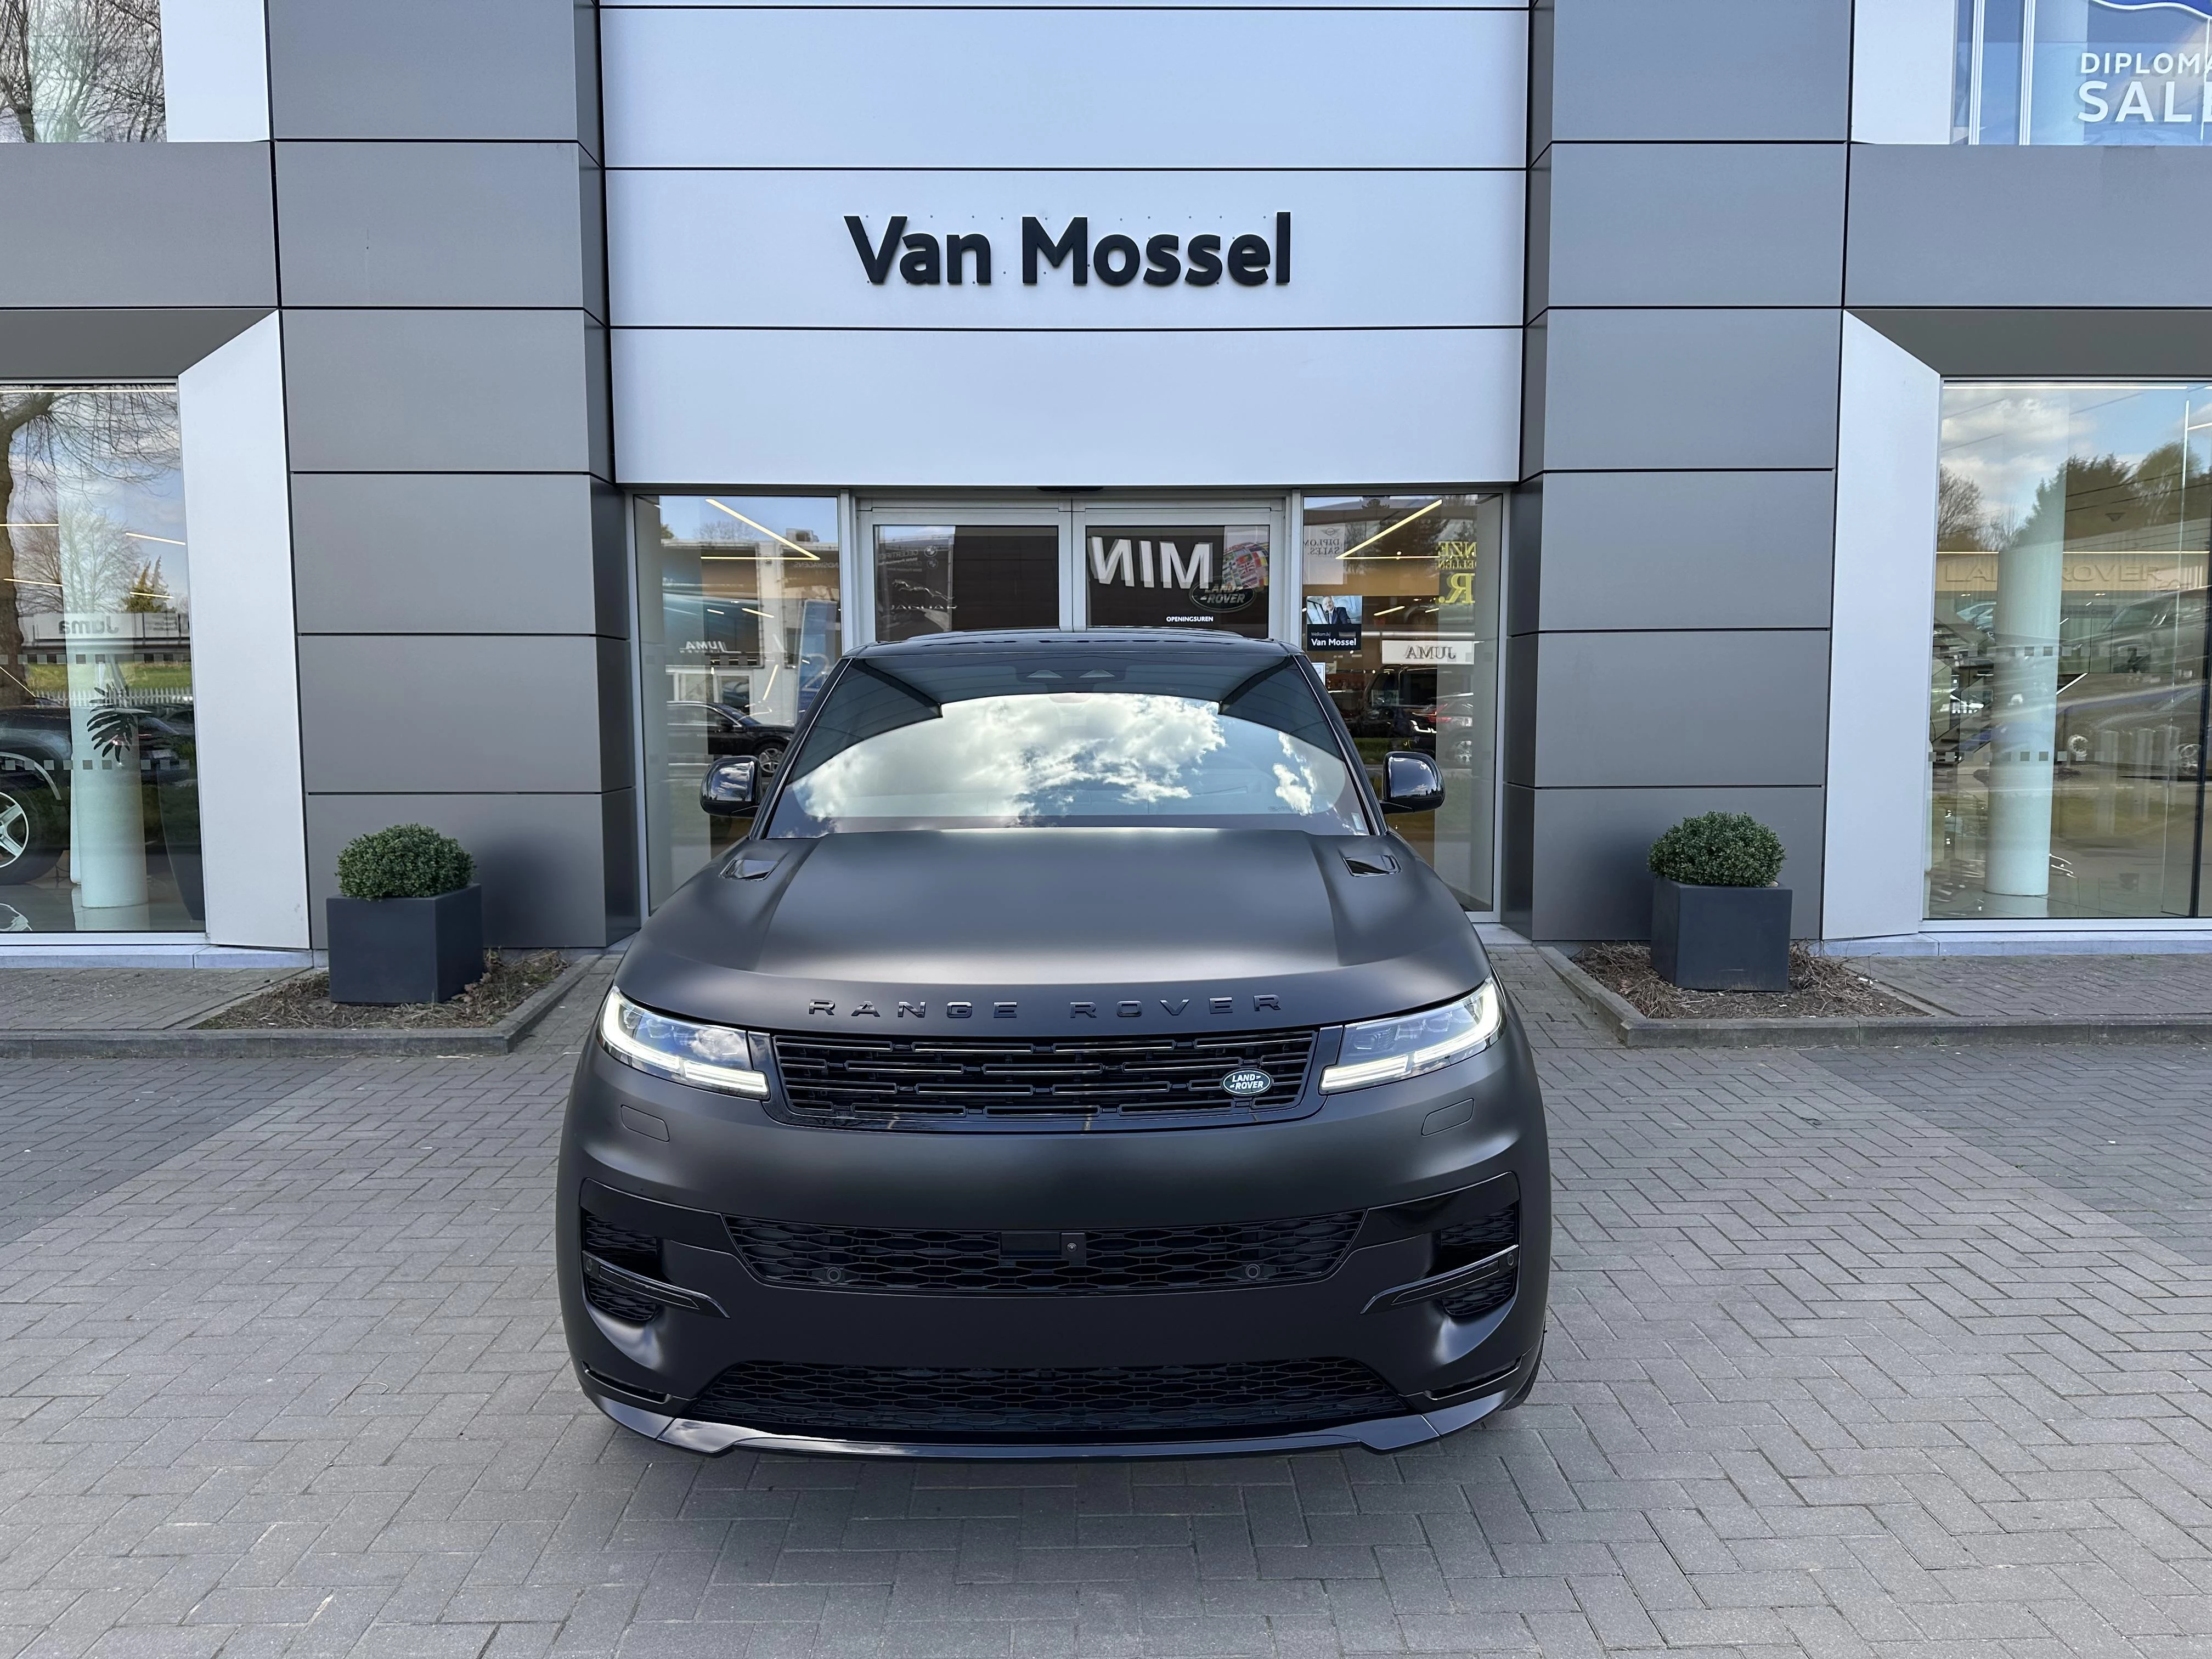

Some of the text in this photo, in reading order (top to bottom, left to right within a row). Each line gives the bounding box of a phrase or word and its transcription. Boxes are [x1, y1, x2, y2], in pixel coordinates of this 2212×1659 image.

[844, 212, 1291, 285] Van Mossel
[1206, 593, 1245, 603] ROVER
[1328, 637, 1357, 646] Mossel
[808, 994, 1282, 1019] RANGE ROVER
[1232, 1074, 1256, 1082] LAND
[1234, 1081, 1264, 1090] ROVER
